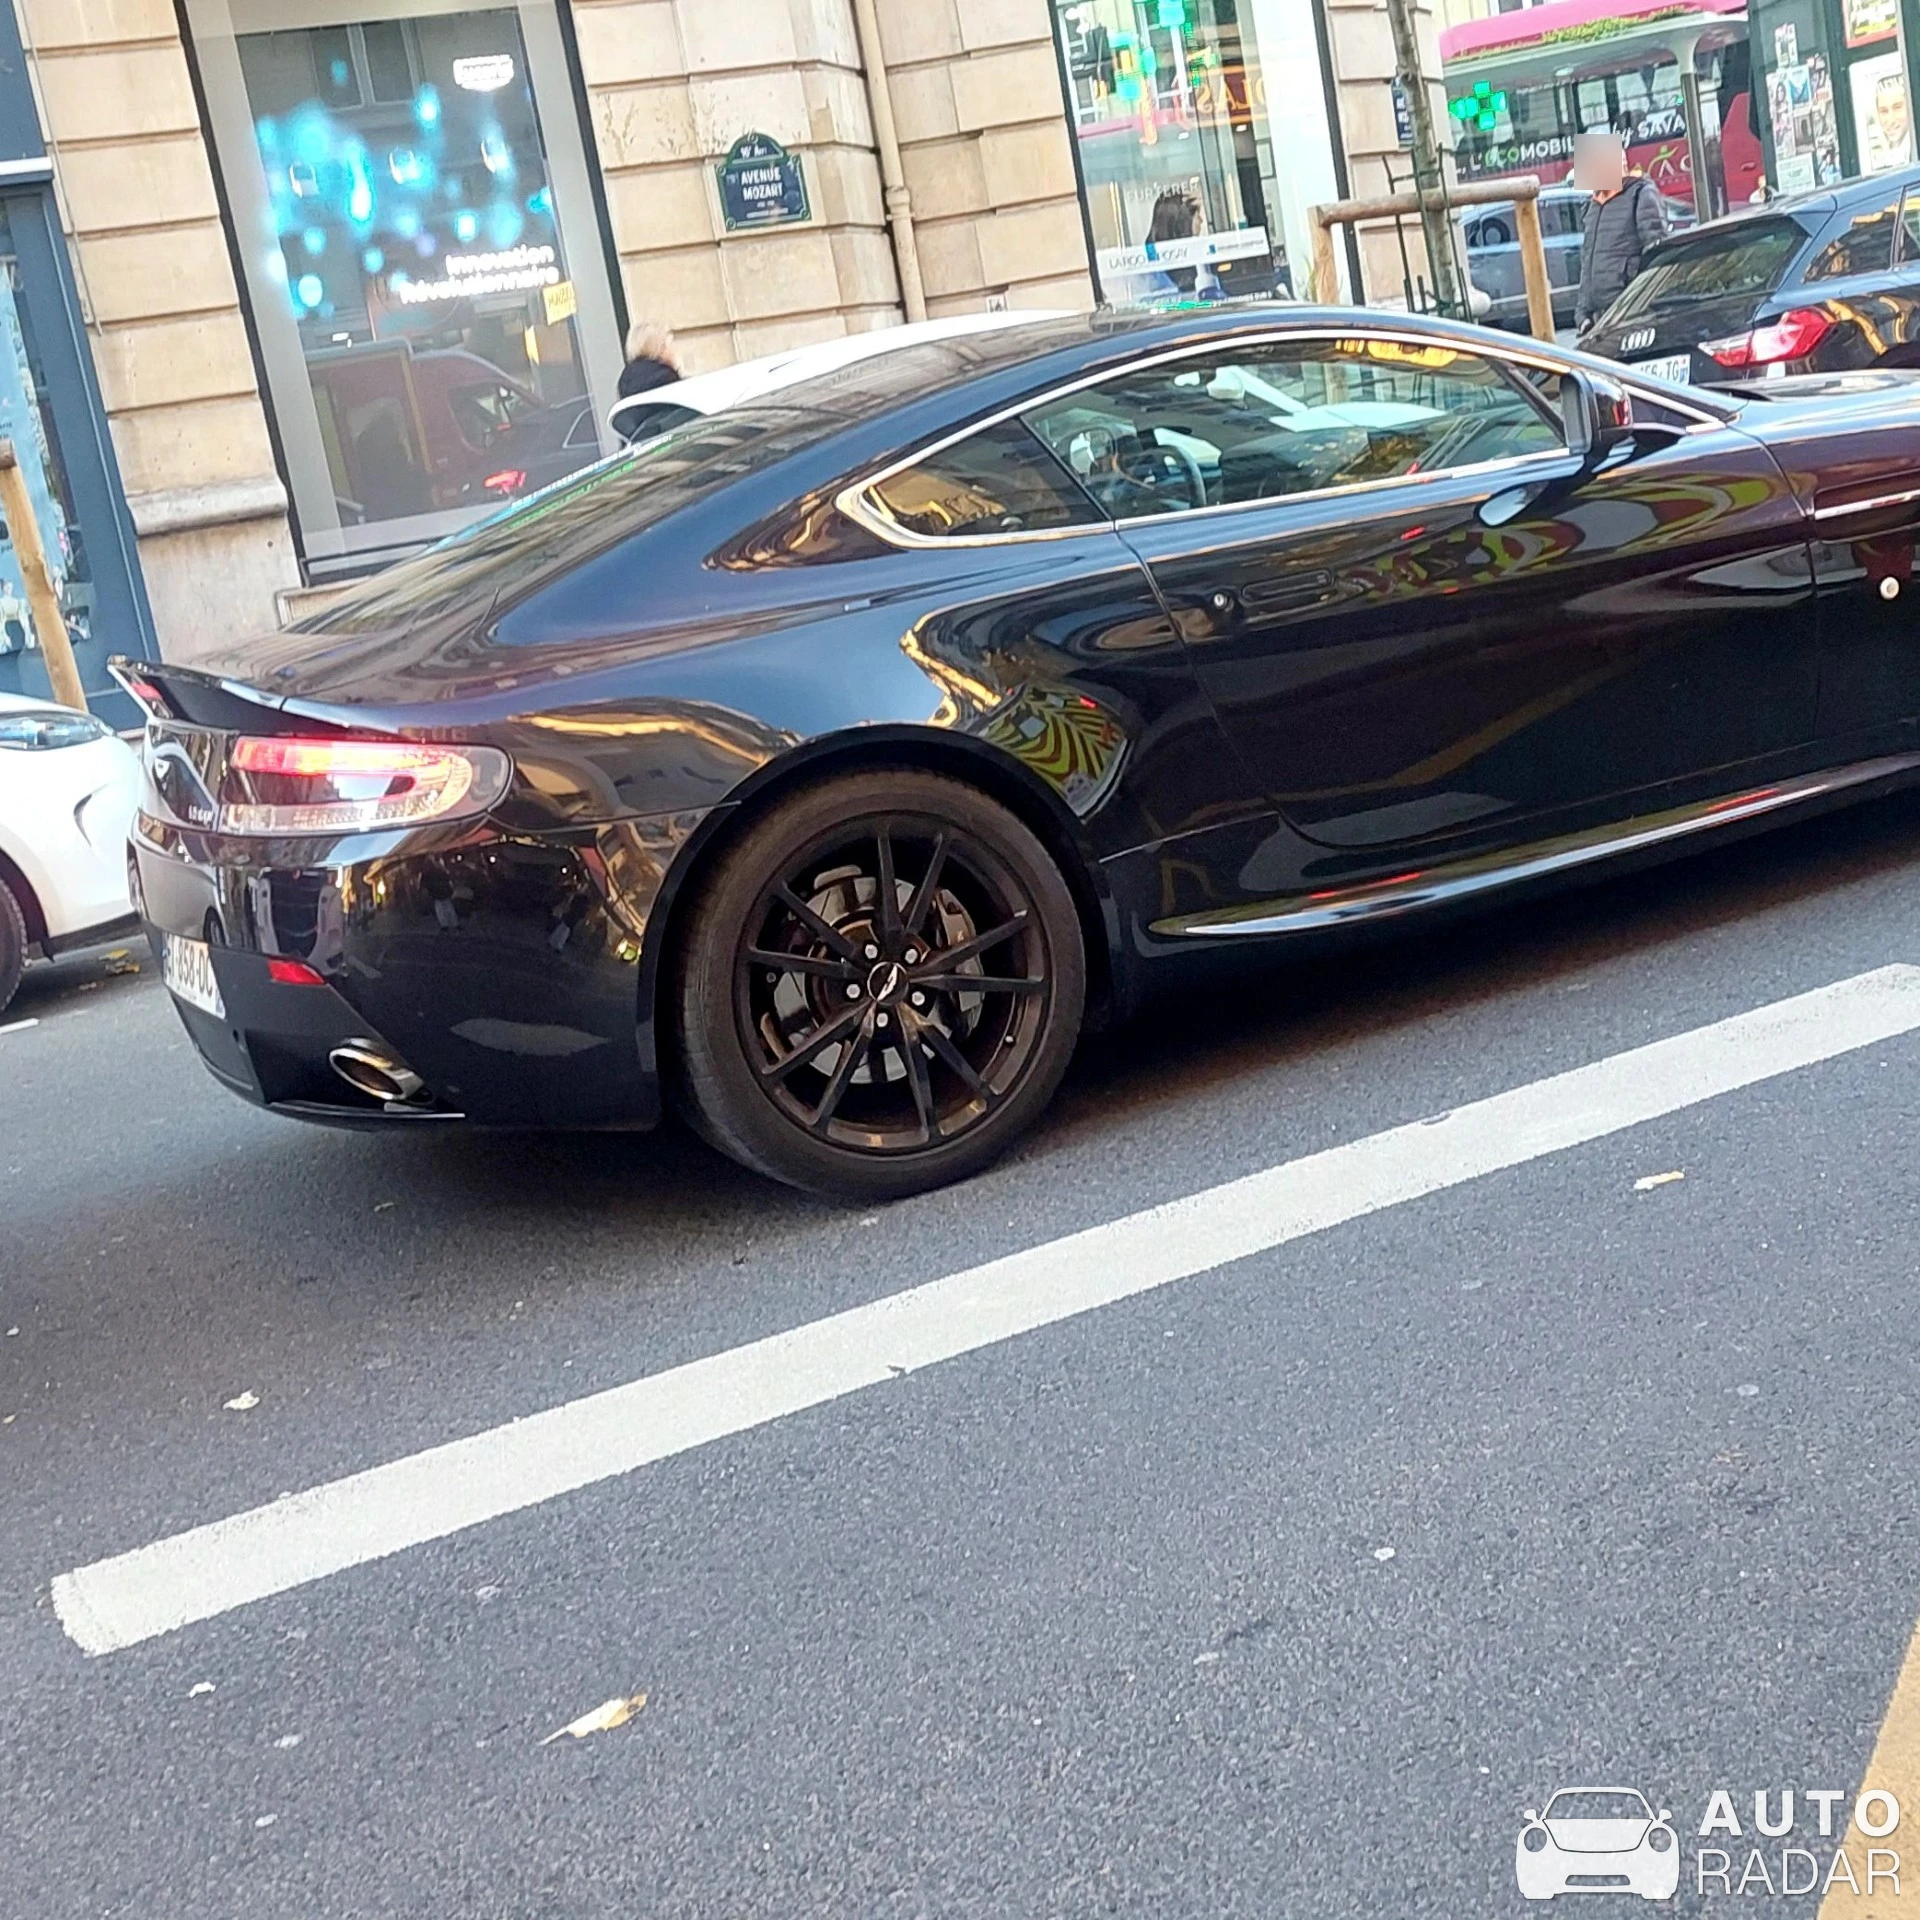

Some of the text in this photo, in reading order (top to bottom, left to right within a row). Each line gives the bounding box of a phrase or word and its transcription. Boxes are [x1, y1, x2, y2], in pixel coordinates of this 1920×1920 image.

[1637, 114, 1686, 139] SAVA
[741, 167, 782, 186] AVENUE
[742, 182, 783, 201] MOZART
[446, 244, 555, 276] Innovation
